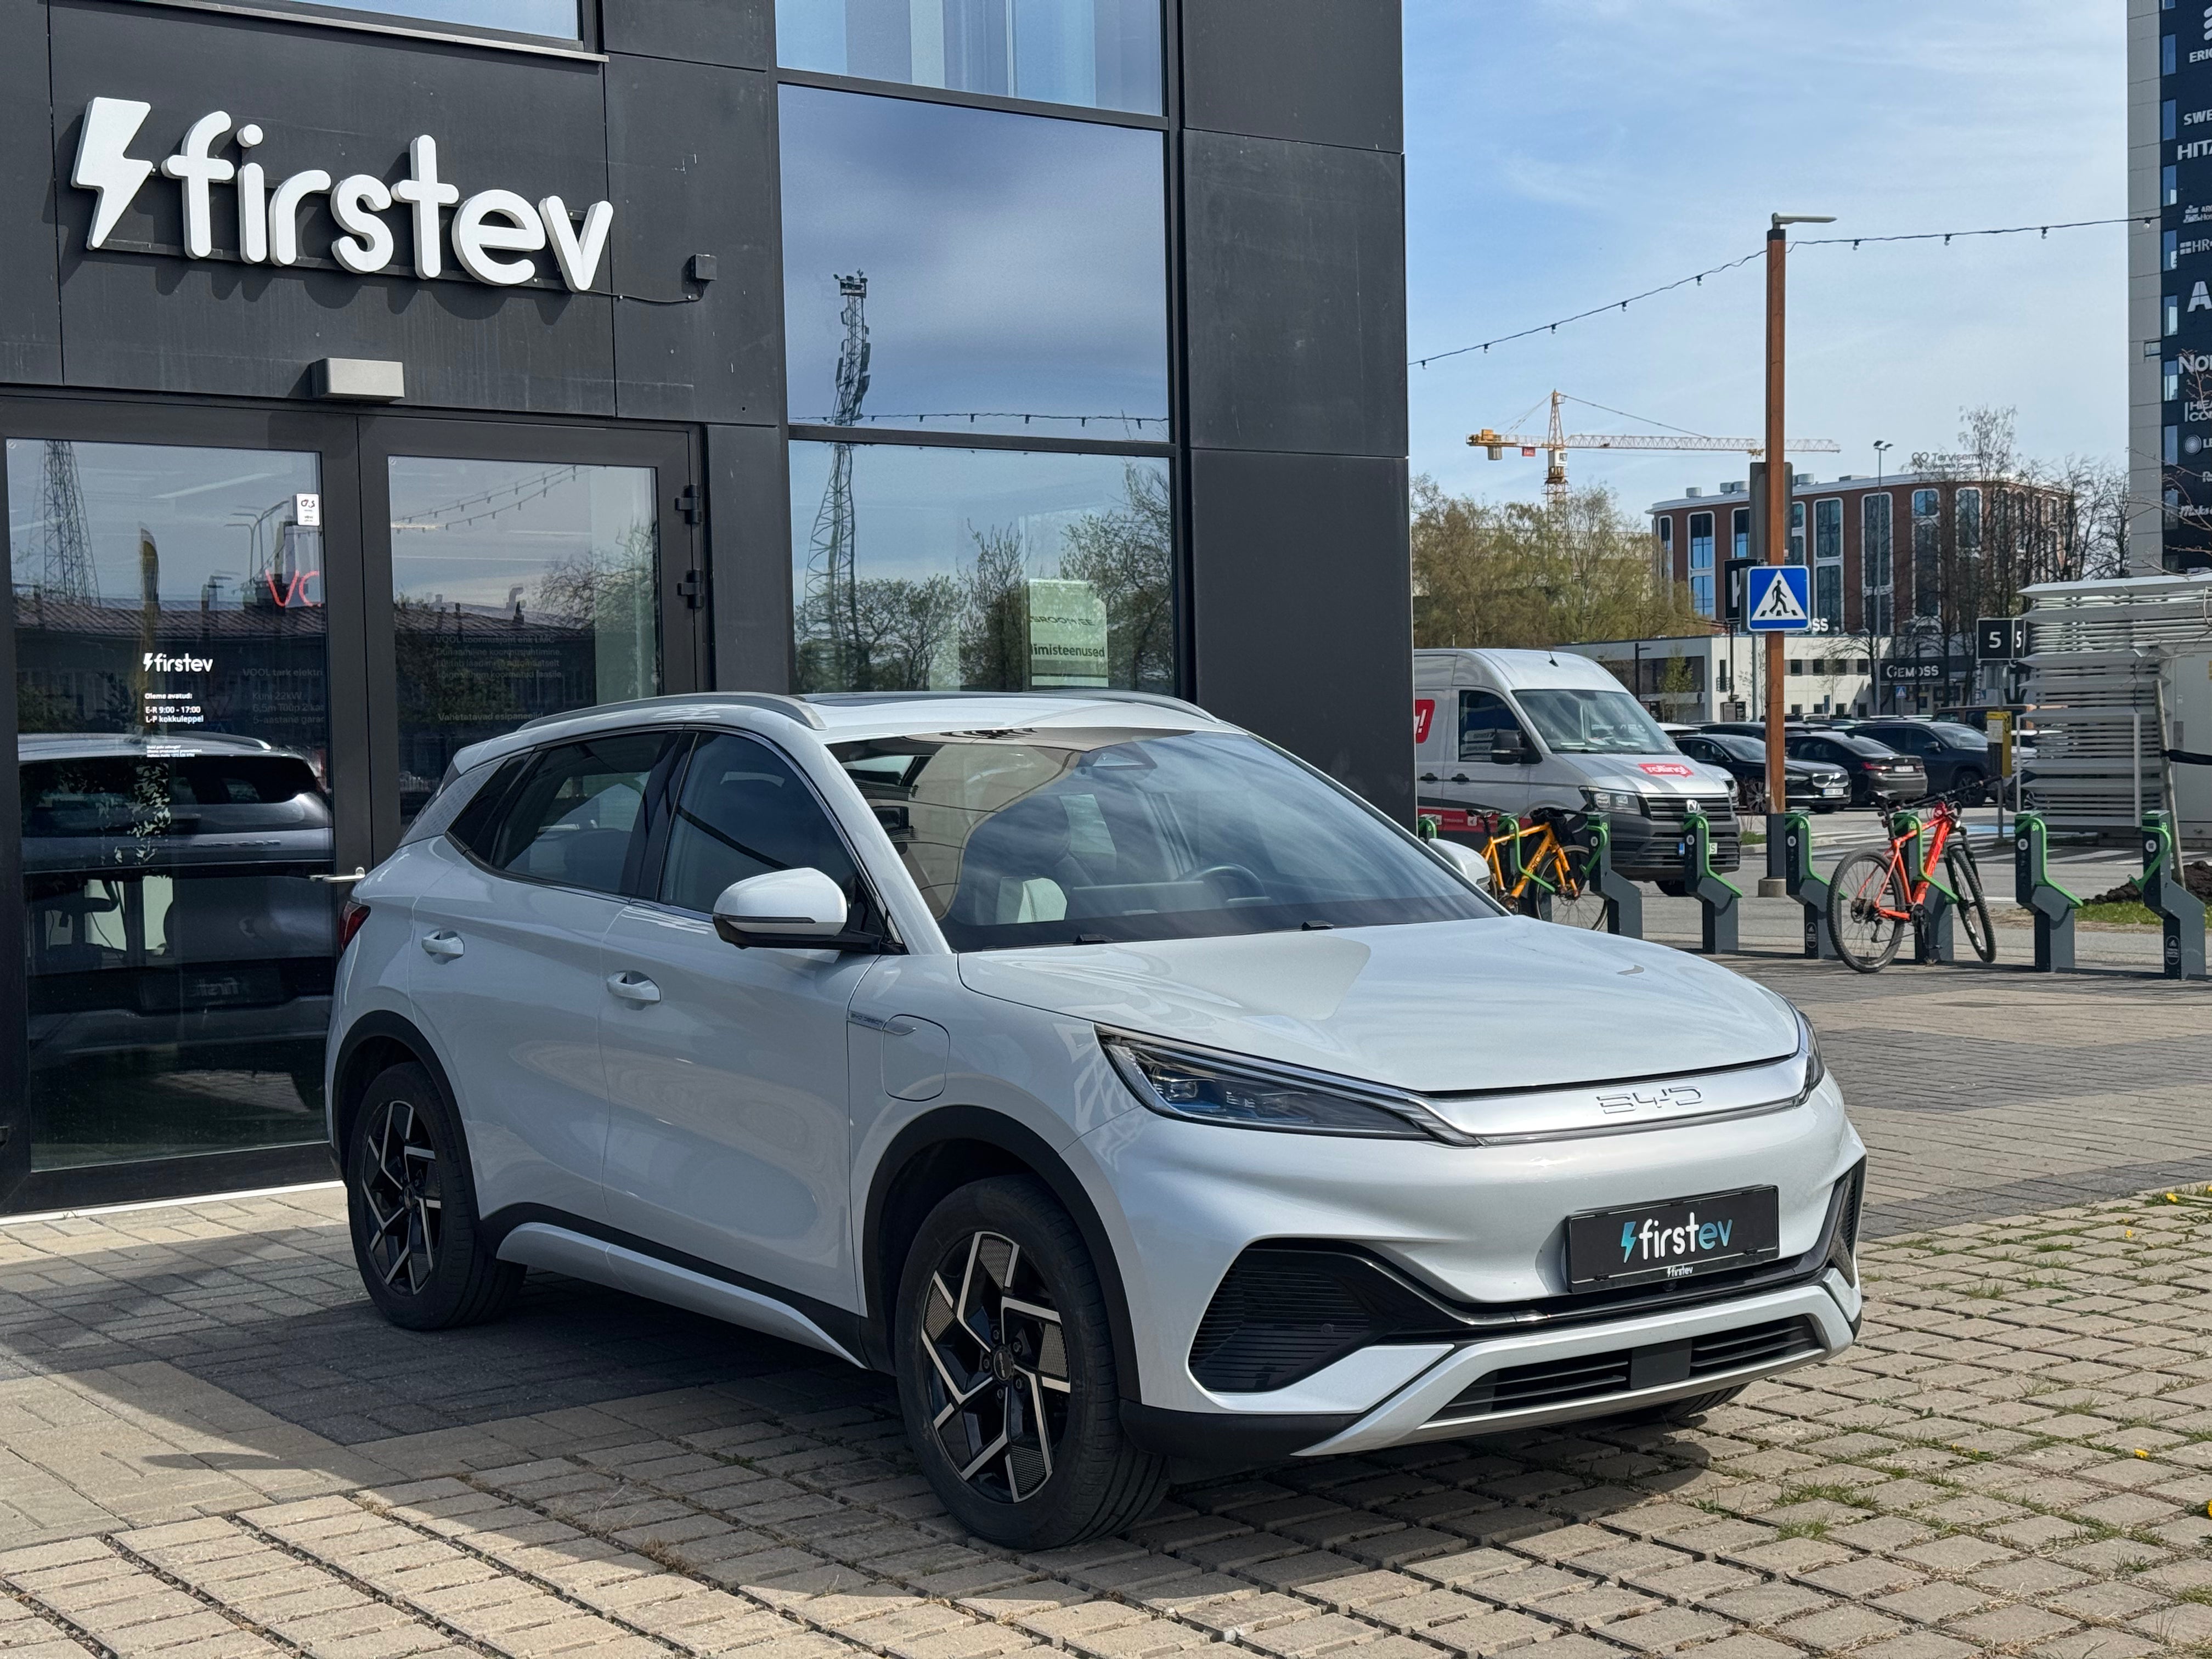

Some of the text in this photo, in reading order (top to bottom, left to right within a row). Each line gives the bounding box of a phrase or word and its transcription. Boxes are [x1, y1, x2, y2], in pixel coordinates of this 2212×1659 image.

[161, 110, 613, 292] firstev
[1809, 618, 1829, 632] SS
[1989, 631, 2001, 648] 5
[2016, 631, 2022, 648] 5
[154, 653, 213, 672] firstev
[159, 715, 204, 724] kokkuleppel
[1596, 1085, 1703, 1114] BYD
[1639, 1212, 1733, 1260] firstev
